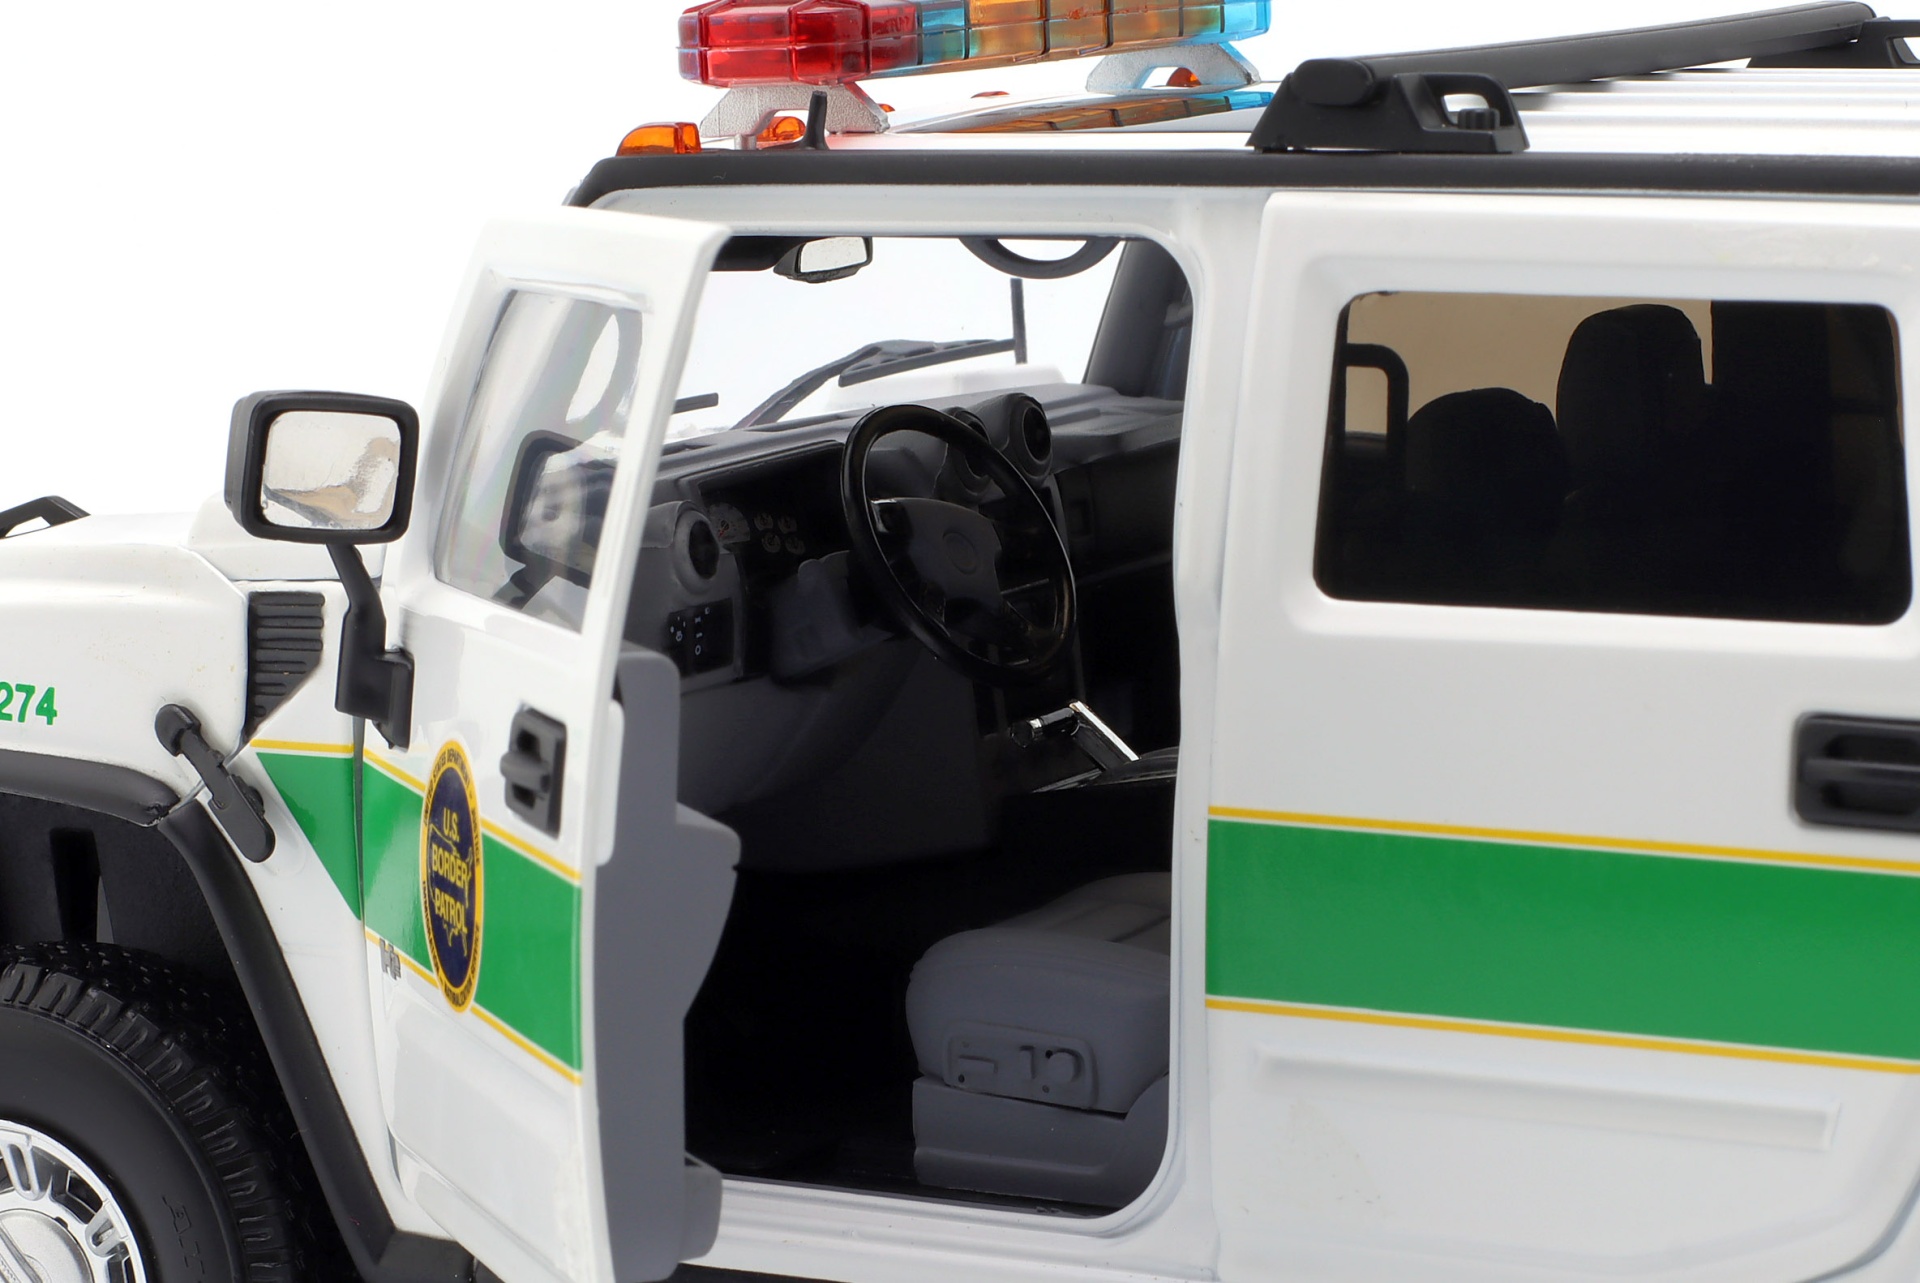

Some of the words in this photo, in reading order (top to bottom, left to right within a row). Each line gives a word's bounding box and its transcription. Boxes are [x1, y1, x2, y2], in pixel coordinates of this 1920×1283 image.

[0, 681, 57, 725] 274
[443, 807, 460, 843] U.S.
[432, 844, 468, 888] BORDER
[434, 887, 468, 934] PATROL
